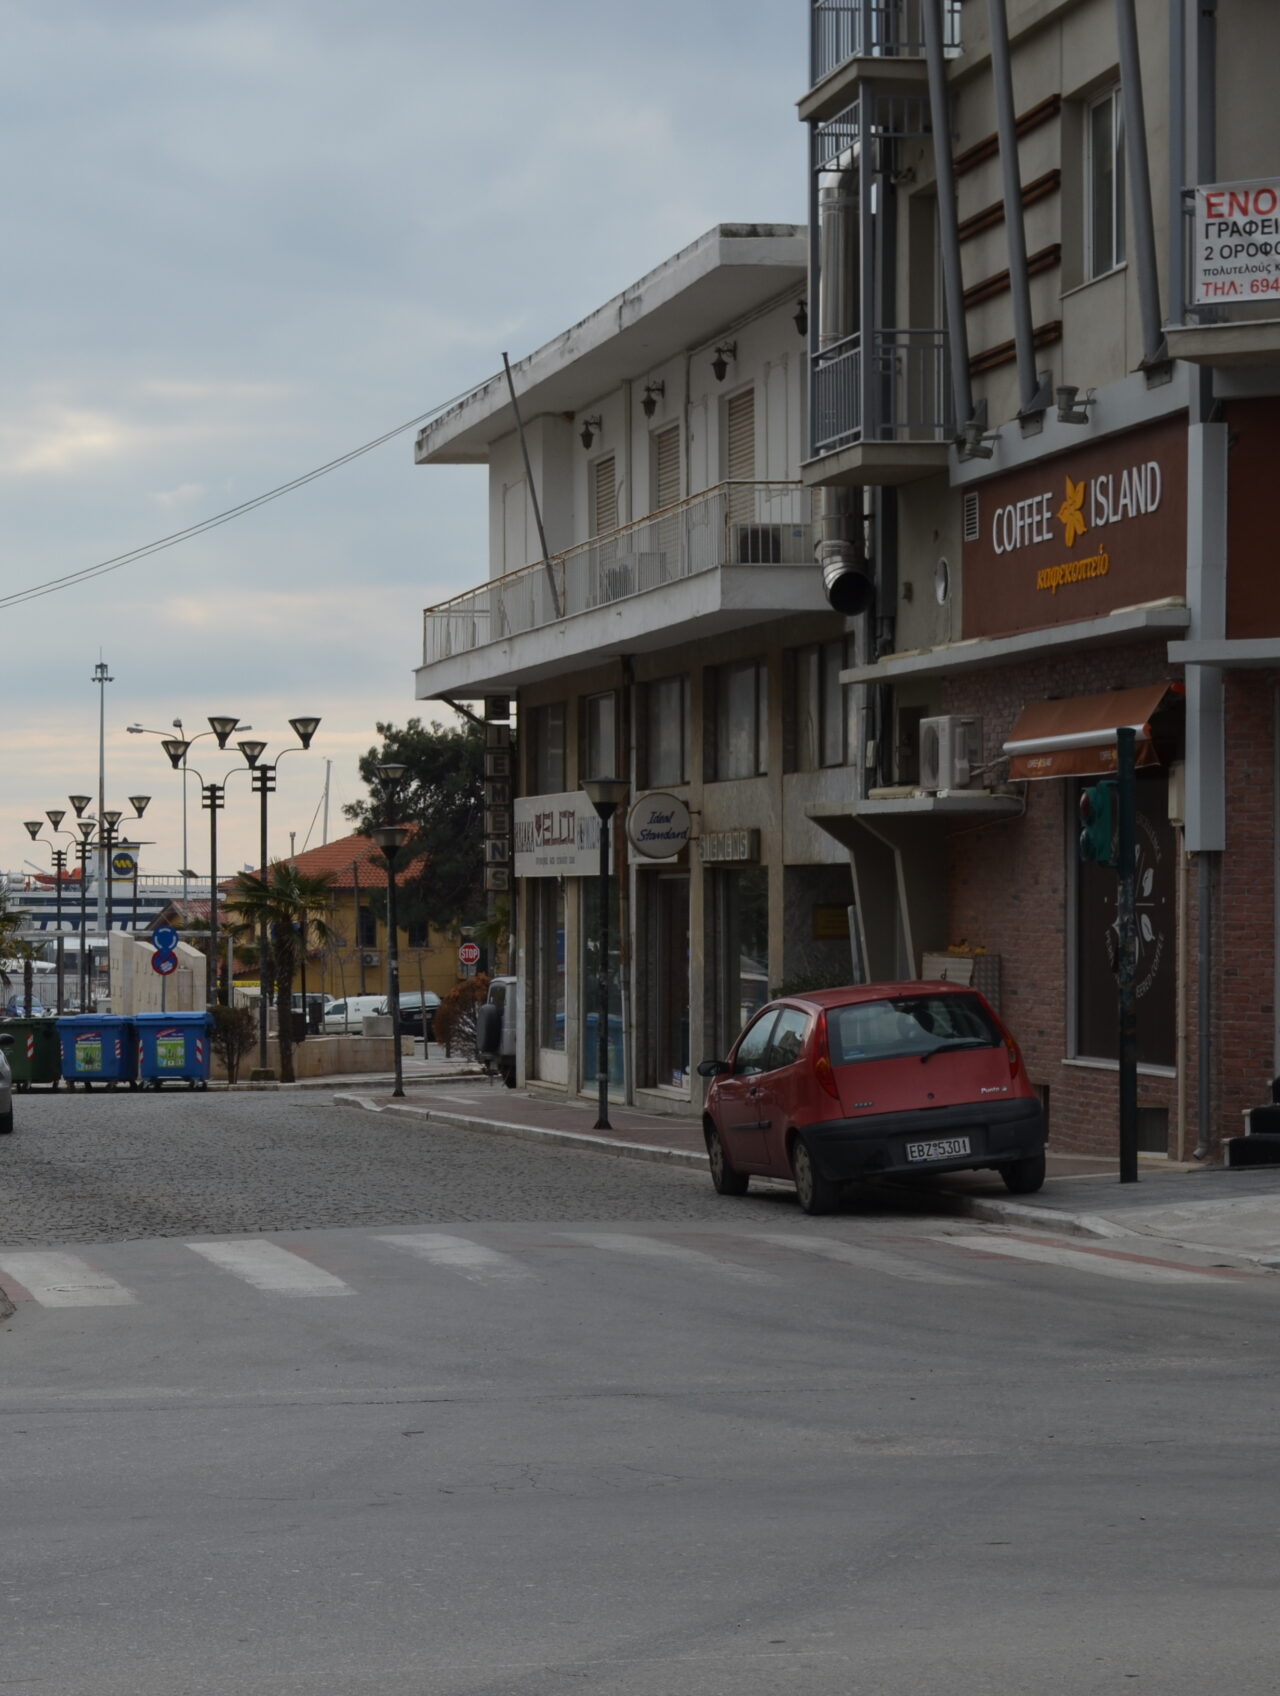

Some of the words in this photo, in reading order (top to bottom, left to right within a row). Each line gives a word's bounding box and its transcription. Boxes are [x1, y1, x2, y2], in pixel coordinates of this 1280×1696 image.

[1204, 246, 1214, 261] 2
[1203, 262, 1271, 277] πολυτελούς
[992, 492, 1054, 555] COFFEE
[1091, 460, 1162, 528] ISLAND
[490, 699, 508, 886] SIEMENS
[647, 810, 675, 825] Ideal
[637, 826, 690, 842] Standard
[700, 831, 748, 861] SIEMENS
[460, 949, 478, 959] STOP
